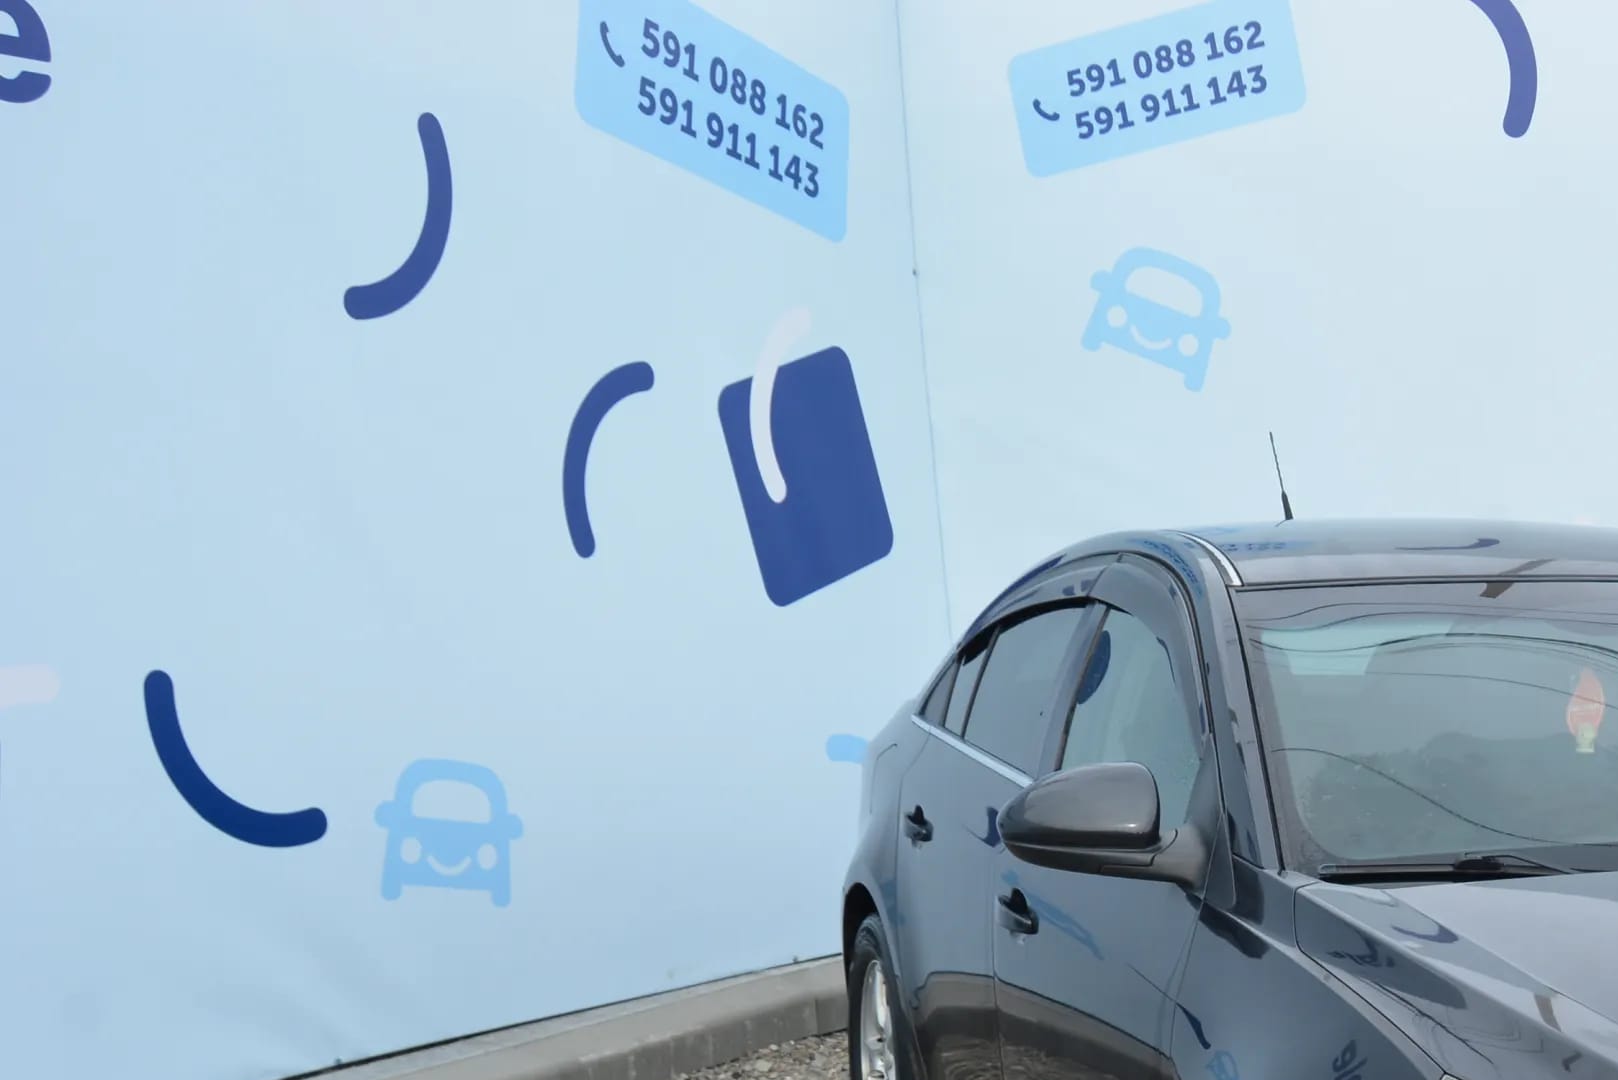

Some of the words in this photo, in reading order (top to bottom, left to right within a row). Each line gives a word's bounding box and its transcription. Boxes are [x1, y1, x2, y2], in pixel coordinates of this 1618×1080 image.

[641, 18, 699, 82] 591
[709, 57, 766, 116] 088
[775, 93, 824, 150] 162
[1067, 58, 1126, 97] 591
[1133, 39, 1196, 79] 088
[1203, 20, 1265, 61] 162
[1075, 101, 1135, 140] 591
[1140, 83, 1201, 122] 911
[1206, 64, 1268, 106] 143
[637, 76, 697, 138] 591
[705, 112, 760, 170] 911
[768, 145, 819, 198] 143
